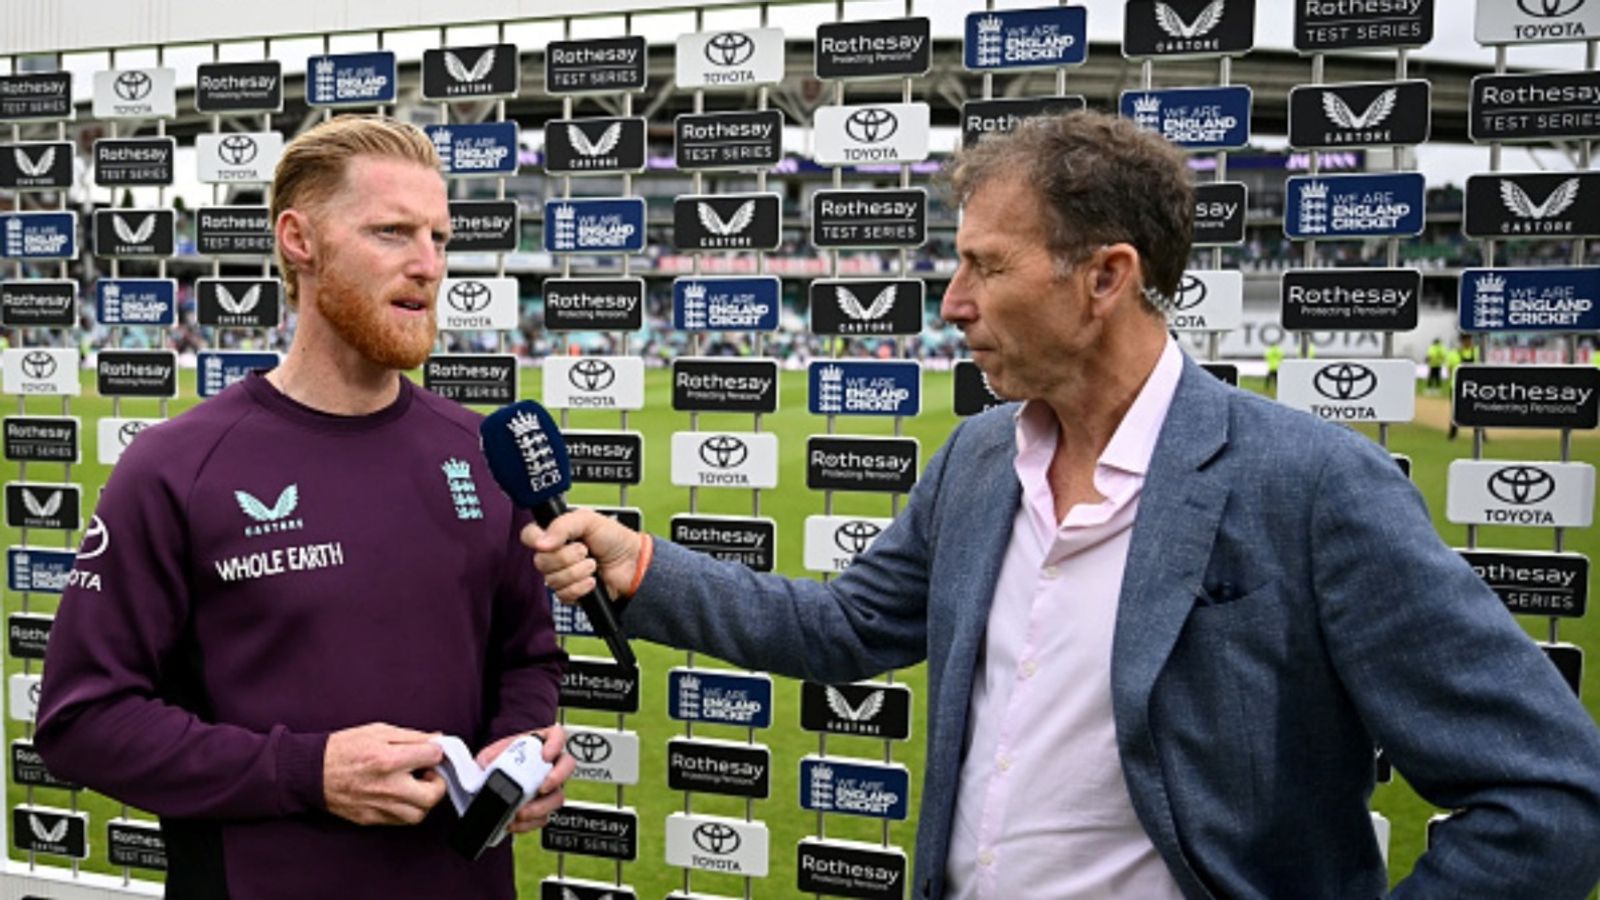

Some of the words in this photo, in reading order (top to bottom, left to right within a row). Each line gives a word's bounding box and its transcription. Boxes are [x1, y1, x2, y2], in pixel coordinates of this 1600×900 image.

[1306, 0, 1420, 16] Rothesay
[1307, 28, 1350, 42] TEST
[1357, 23, 1420, 39] SERIES
[1514, 23, 1585, 39] TOYOTA
[822, 35, 922, 53] Rothesay
[1005, 35, 1074, 49] ENGLAND
[1156, 40, 1219, 52] CASTORE
[553, 48, 637, 64] Rothesay
[1005, 47, 1065, 60] CRICKET
[201, 76, 276, 90] Rothesay
[555, 73, 584, 85] TEST
[590, 70, 637, 83] SERIES
[704, 70, 754, 82] TOYOTA
[1, 81, 65, 96] Rothesay
[1482, 85, 1600, 103] Rothesay
[114, 105, 152, 114] TOYOTA
[1164, 107, 1185, 118] WE
[1192, 106, 1222, 117] ARE
[1164, 117, 1236, 132] ENGLAND
[1484, 117, 1527, 131] TEST
[1538, 114, 1600, 128] SERIES
[684, 123, 772, 138] Rothesay
[1164, 130, 1226, 142] CRICKET
[100, 146, 167, 162] Rothesay
[685, 149, 717, 160] TEST
[723, 146, 771, 159] SERIES
[844, 148, 898, 159] TOYOTA
[101, 169, 127, 179] TEST
[129, 169, 168, 179] SERIES
[218, 170, 257, 179] TOYOTA
[1333, 194, 1357, 203] WE
[1364, 192, 1394, 202] ARE
[821, 201, 916, 217] Rothesay
[1332, 205, 1410, 219] ENGLAND
[202, 216, 271, 230] Rothesay
[451, 215, 513, 232] thesay
[1332, 217, 1399, 230] CRICKET
[1502, 222, 1572, 232] CASTORE
[822, 227, 857, 239] TEST
[864, 226, 916, 239] SERIES
[203, 239, 231, 248] TEST
[1288, 286, 1411, 307] Rothesay
[1509, 288, 1534, 298] WE
[1541, 287, 1574, 298] ARE
[2, 294, 71, 308] Rothesay
[548, 293, 637, 311] Rothesay
[1509, 300, 1592, 312] ENGLAND
[447, 317, 492, 326] TOYOTA
[1509, 312, 1579, 324] CRICKET
[100, 362, 171, 379] Rothesay
[429, 362, 509, 380] Rothesay
[22, 383, 57, 392] TOYOTA
[677, 373, 771, 394] Rothesay
[846, 378, 866, 387] WE
[870, 378, 895, 387] ARE
[429, 386, 460, 397] TEST
[465, 386, 509, 398] SERIES
[846, 389, 909, 401] ENGLAND
[1462, 381, 1593, 406] Rothesay
[568, 396, 615, 406] TOYOTA
[846, 400, 900, 411] CRICKET
[1312, 405, 1376, 419] TOYOTA
[8, 424, 71, 440] Rothesay
[10, 445, 34, 455] TEST
[37, 446, 71, 457] SERIES
[810, 450, 911, 472] Rothesay
[588, 467, 633, 478] SERIES
[700, 472, 748, 484] TOYOTA
[531, 468, 562, 492] ECB
[1485, 510, 1554, 524] TOYOTA
[245, 519, 303, 537] CASTORE
[677, 525, 765, 545] Rothesay
[215, 552, 284, 580] WHOLE
[286, 542, 344, 570] EARTH
[70, 569, 101, 591] OTA
[1477, 564, 1575, 586] othesay
[1507, 593, 1574, 609] SERIES
[11, 626, 50, 640] Rothe
[561, 674, 634, 694] othesay
[671, 753, 763, 778] Rothesay
[836, 788, 898, 803] ENGLAND
[548, 813, 628, 835] Rothesay
[692, 855, 741, 871] TOYOTA
[802, 855, 898, 885] Rothesay
